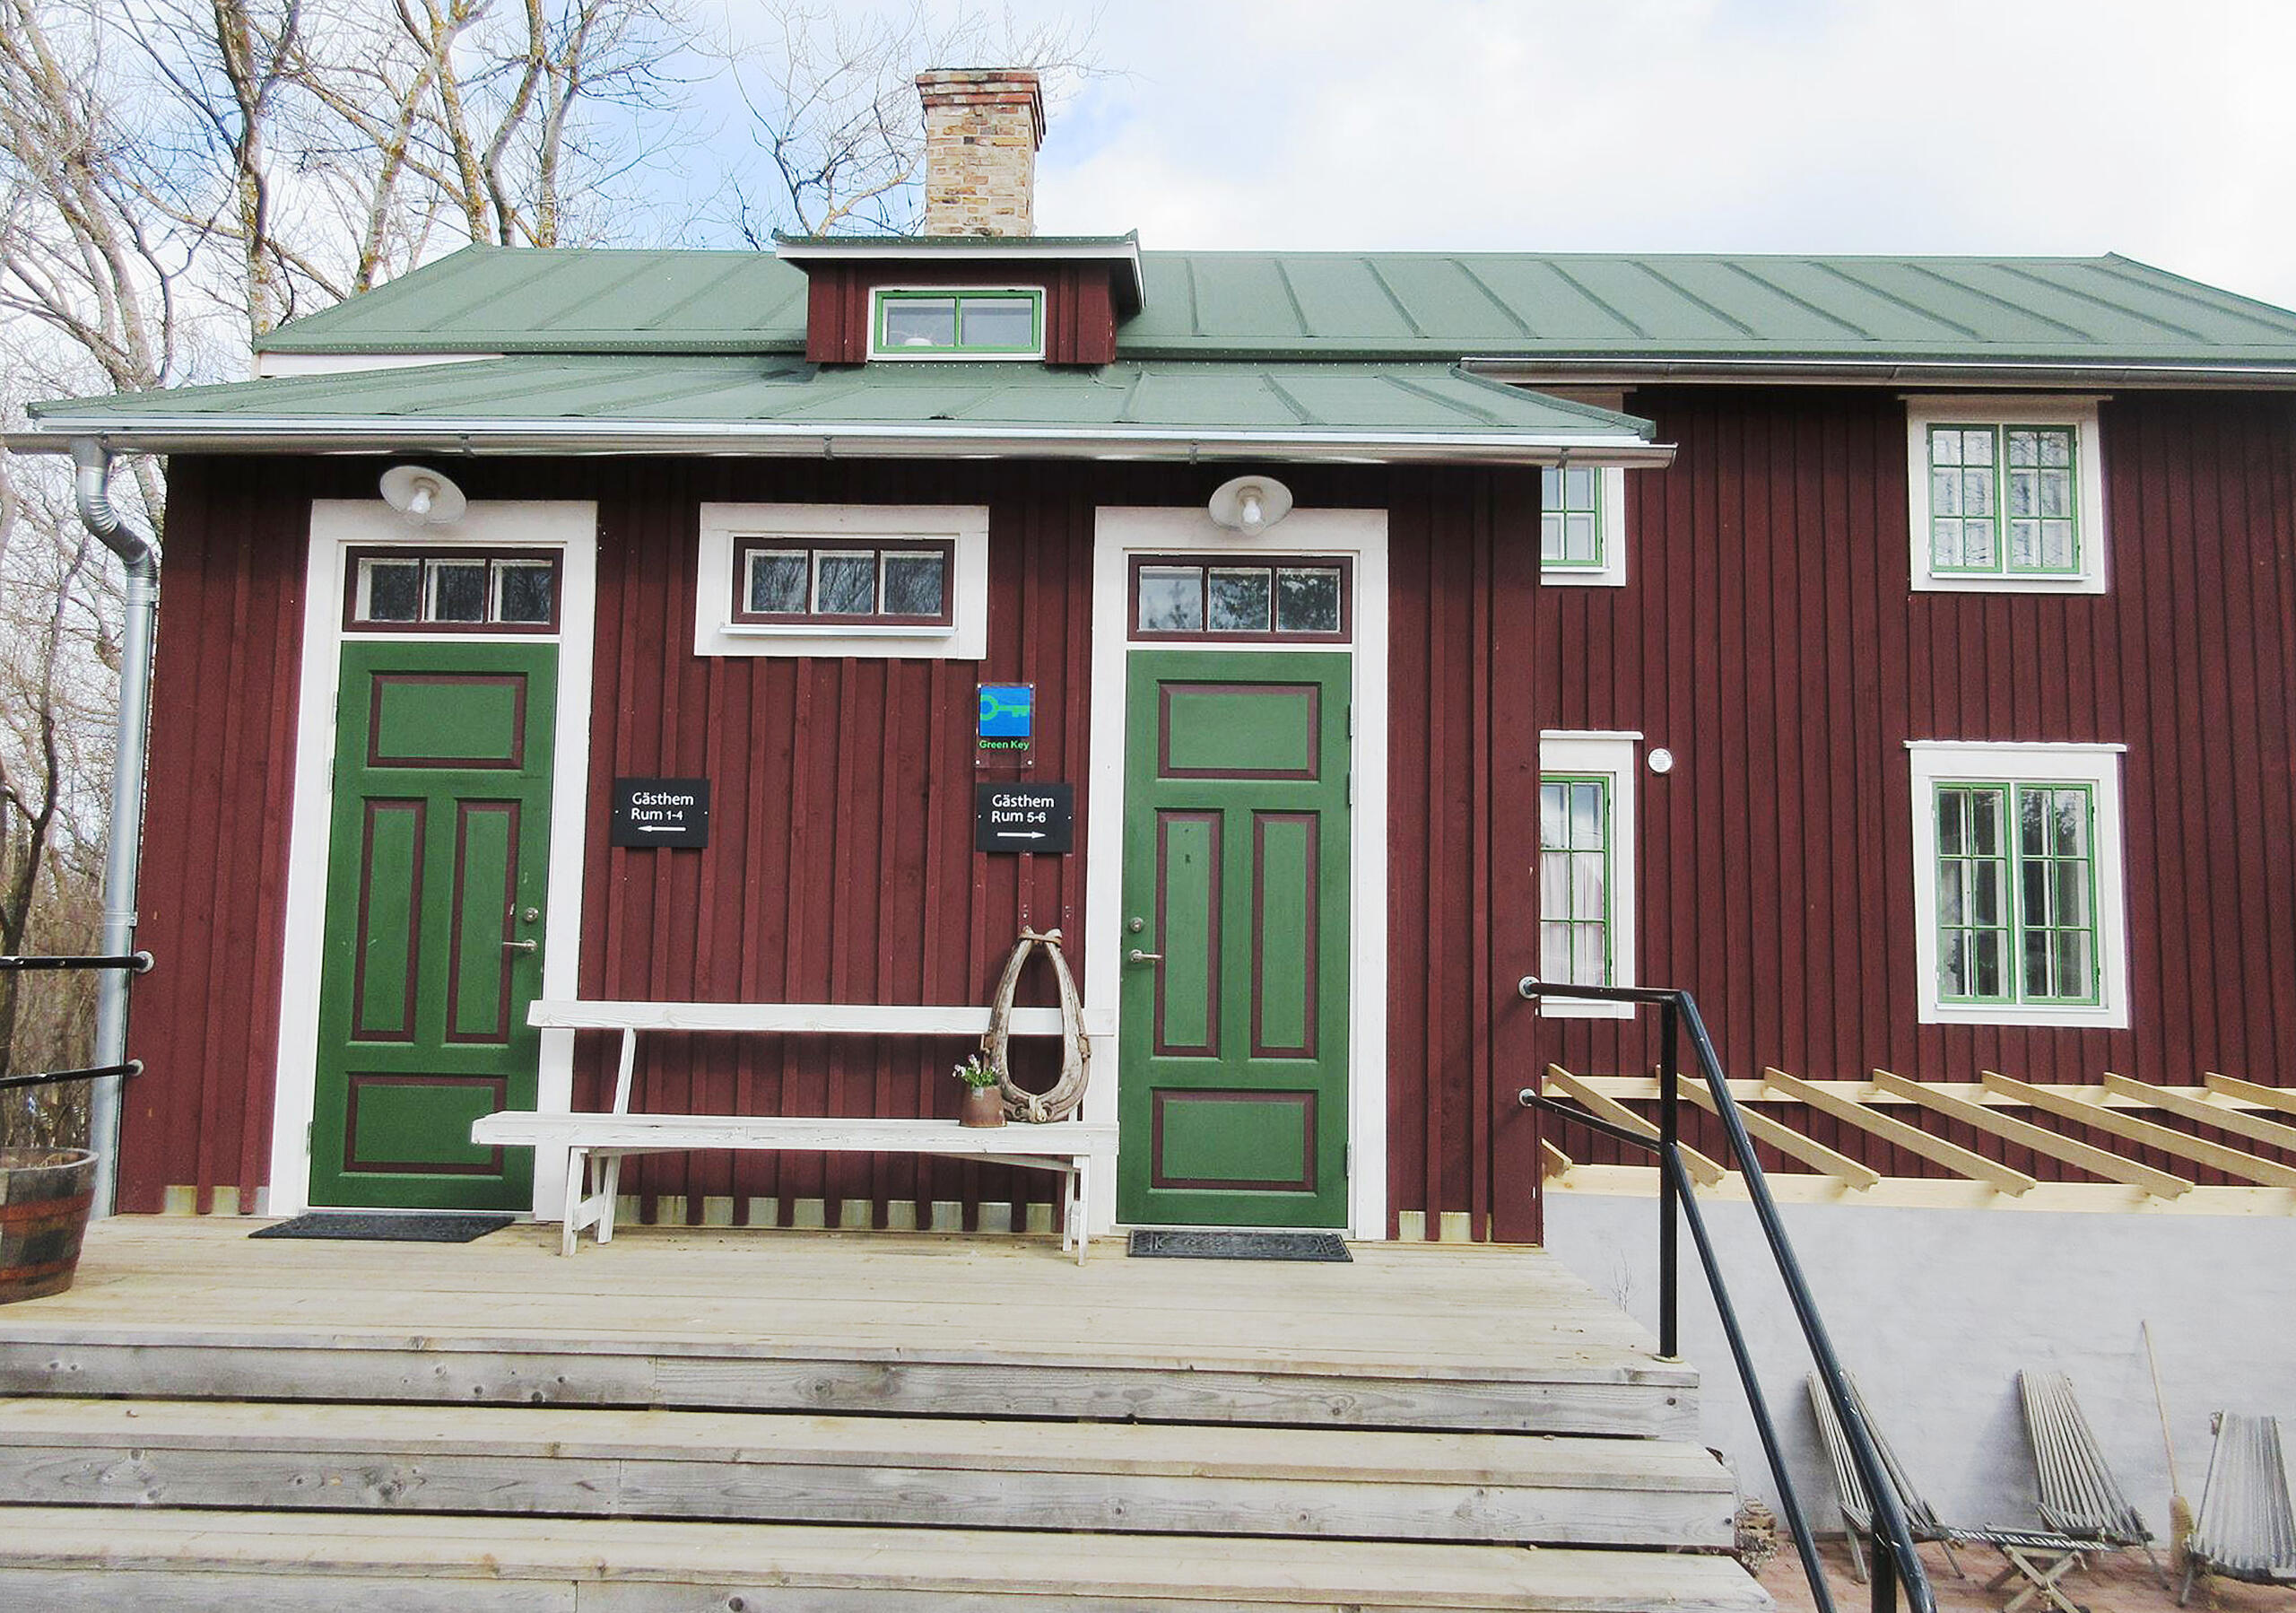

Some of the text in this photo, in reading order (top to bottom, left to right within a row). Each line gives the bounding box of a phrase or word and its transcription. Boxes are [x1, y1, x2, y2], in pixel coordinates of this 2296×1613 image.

[978, 739, 1030, 751] Green Key
[631, 791, 694, 806] Gästhem
[991, 794, 1055, 807] Gästhem
[631, 807, 683, 821] Rum 1-4
[991, 810, 1047, 824] Rum 5-6
